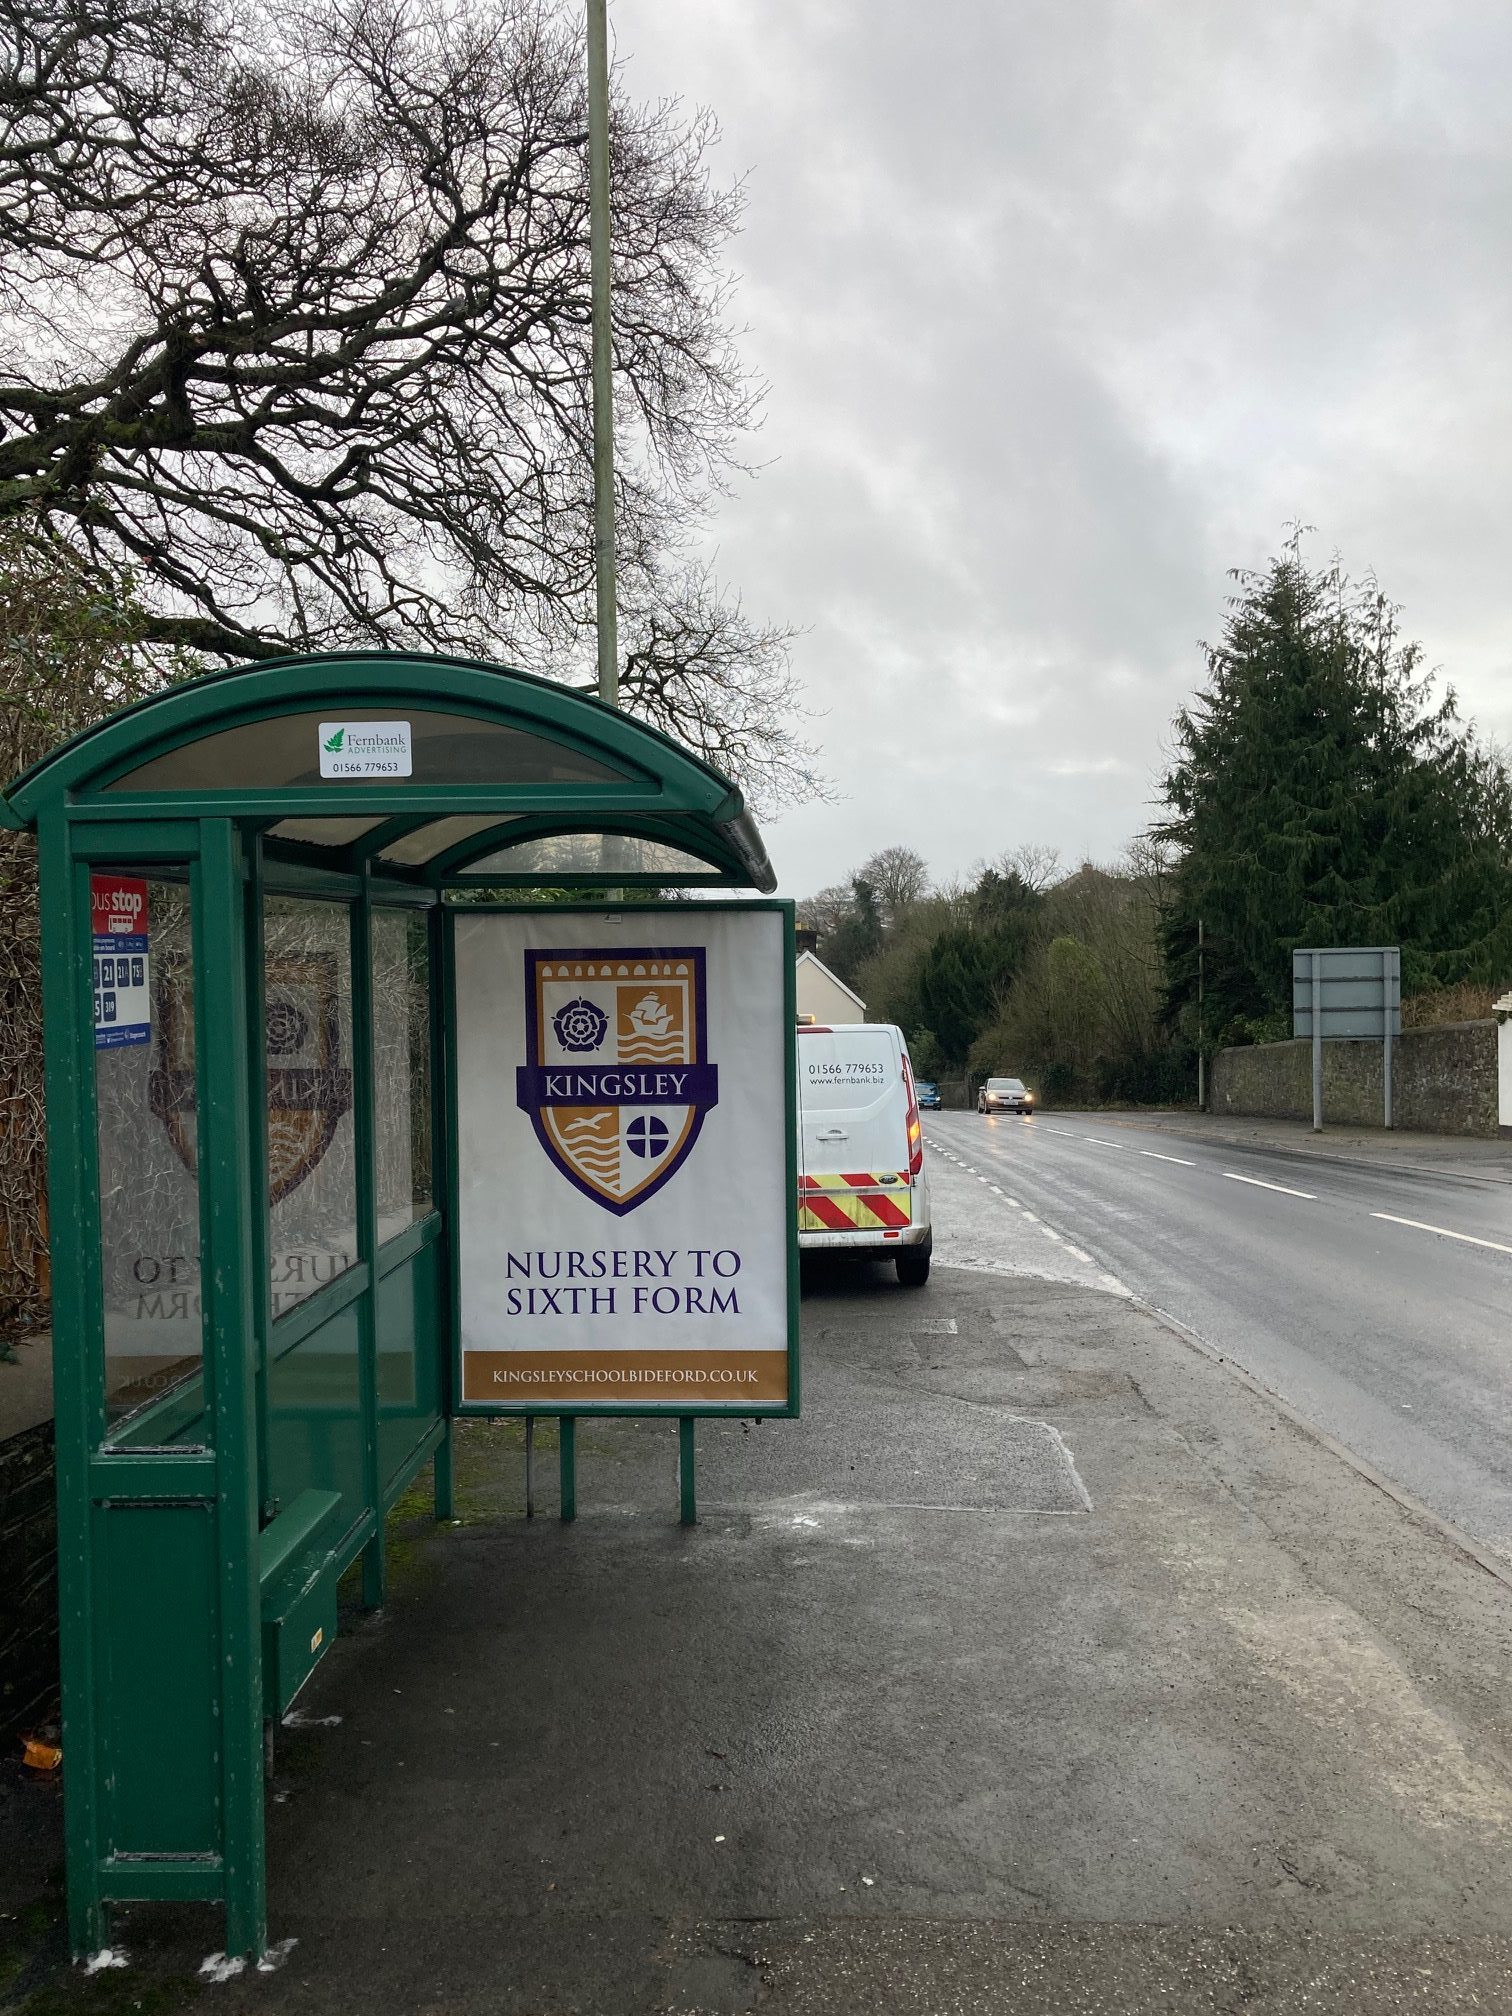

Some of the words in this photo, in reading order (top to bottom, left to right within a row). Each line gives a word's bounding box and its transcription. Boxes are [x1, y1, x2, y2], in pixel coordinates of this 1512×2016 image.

[347, 733, 406, 746] Fernbank
[347, 746, 407, 754] ADVERTISING
[333, 763, 361, 772] 01566
[365, 763, 398, 772] 779653
[111, 887, 142, 919] stop
[103, 965, 113, 981] 21
[105, 1001, 115, 1013] 319
[808, 1064, 842, 1074] 01566
[845, 1063, 884, 1074] 779653
[545, 1073, 688, 1097] KINGSLEY
[809, 1076, 884, 1085] www.fernbank.biz
[505, 1250, 679, 1279] NURSERY
[687, 1250, 742, 1278] TO
[506, 1287, 618, 1316] SIXTH
[632, 1286, 743, 1315] FORM
[493, 1370, 759, 1383] KINGSLEYSCHOOLBIDEFORD.CO.UK
